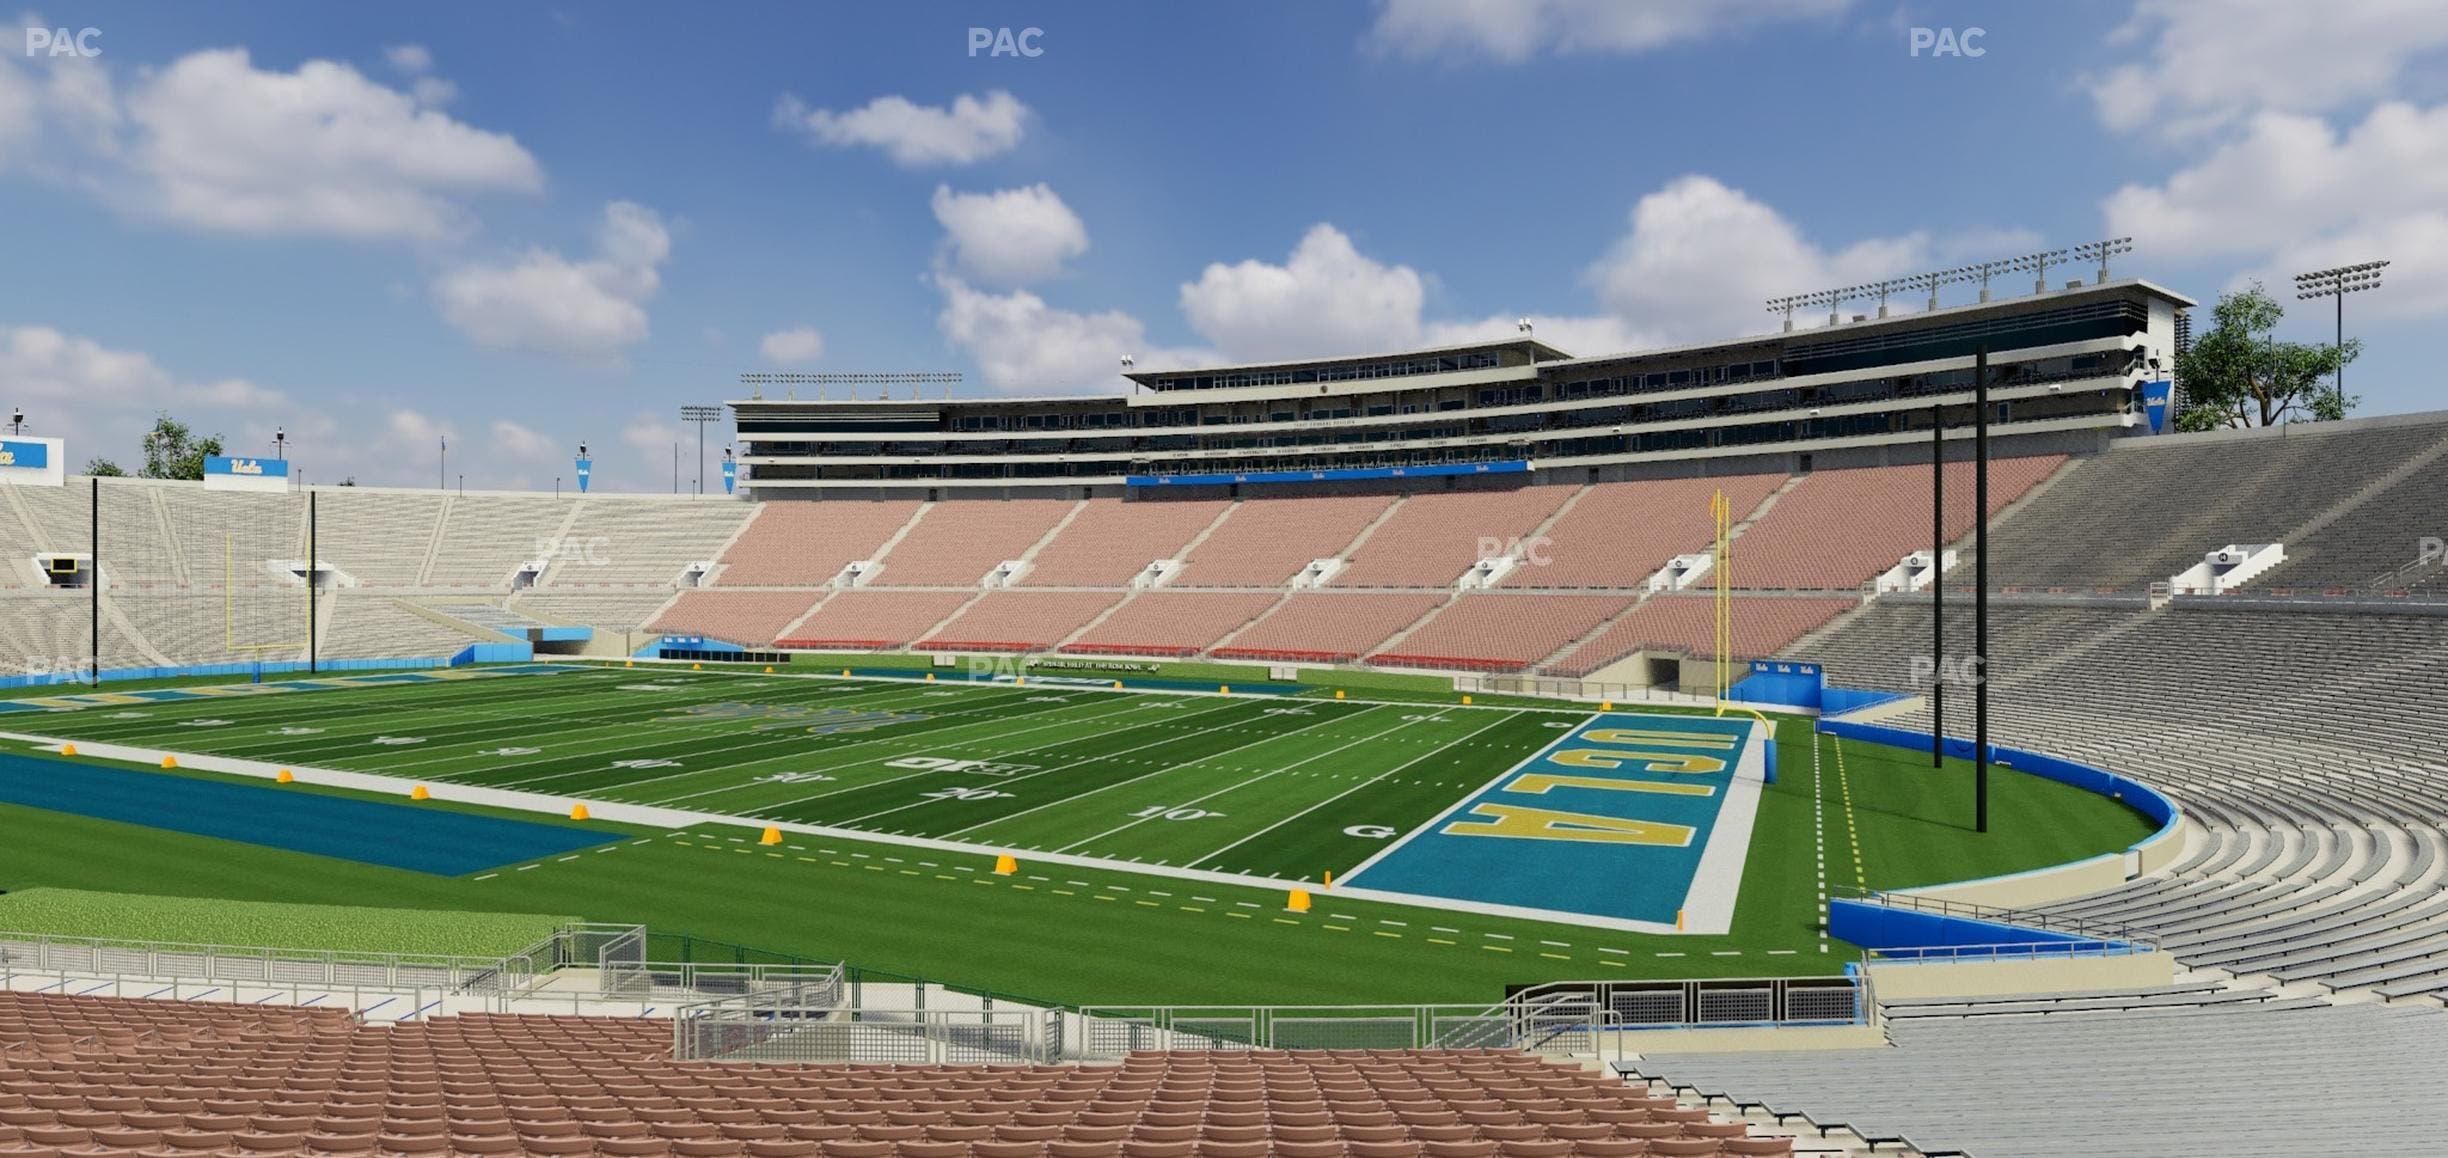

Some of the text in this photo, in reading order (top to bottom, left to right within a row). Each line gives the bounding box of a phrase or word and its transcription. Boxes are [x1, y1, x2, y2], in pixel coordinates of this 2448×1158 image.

[918, 786, 1000, 800] 20
[1439, 729, 1739, 847] UCLA
[1127, 805, 1207, 821] 10
[1343, 824, 1397, 839] G
